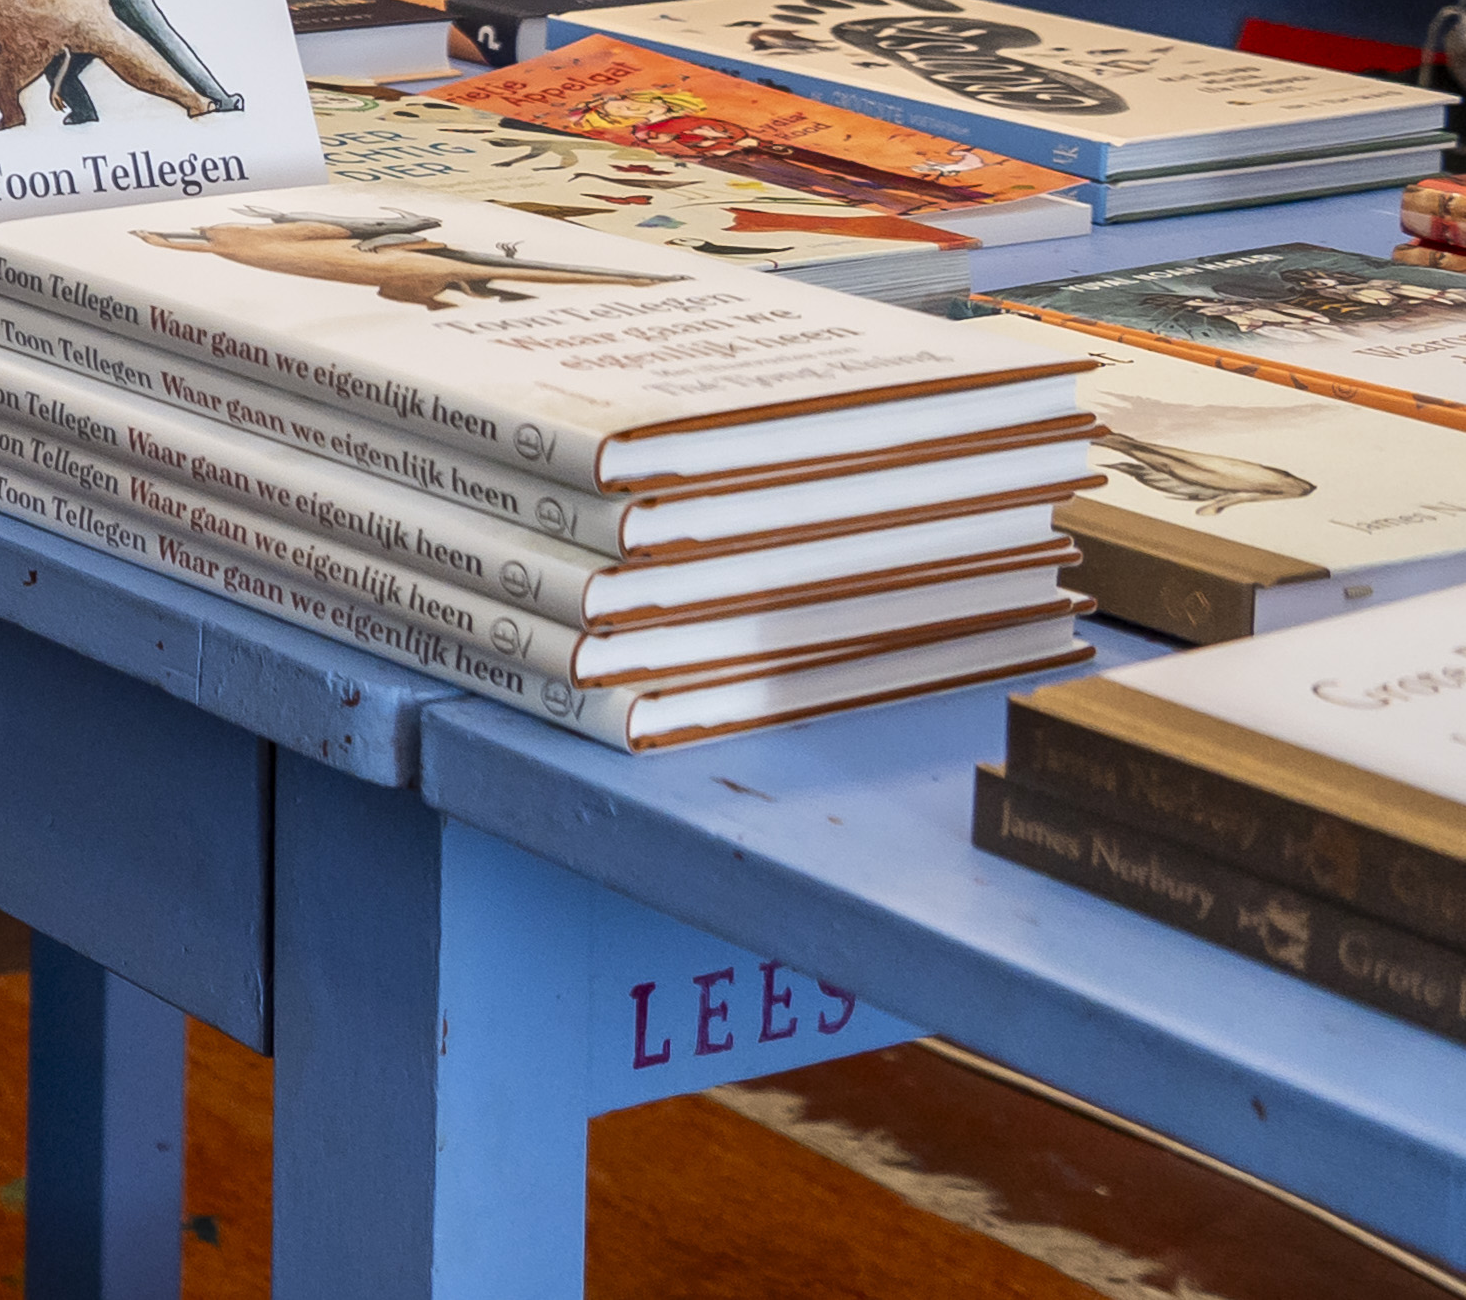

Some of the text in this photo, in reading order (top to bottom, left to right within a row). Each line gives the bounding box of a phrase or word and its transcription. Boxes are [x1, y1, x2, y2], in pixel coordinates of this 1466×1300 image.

[82, 150, 251, 205] Tellegen
[332, 161, 471, 183] DIER
[1133, 264, 1199, 281] NOAH
[1197, 253, 1285, 271] HARARI
[433, 290, 748, 337] Toon Tellegen
[487, 305, 804, 353] Waar gaan we
[747, 324, 866, 353] heen
[47, 275, 141, 330] Tellegen
[149, 303, 209, 350] Waar
[211, 327, 271, 372] gaan
[275, 350, 311, 380] we
[312, 361, 425, 425] eigenlijk
[431, 391, 499, 443] heen
[0, 317, 522, 516] Toon Tellegen Waar gaan we eigenlijk heen
[24, 390, 119, 447] Tellegen
[126, 425, 188, 471] Waar
[190, 451, 250, 497] gaan
[255, 480, 291, 508] we
[294, 490, 410, 550] eigenlijk
[414, 529, 485, 580] heen
[29, 437, 120, 496] Tellegen
[127, 475, 188, 524] Waar
[189, 504, 249, 550] gaan
[253, 532, 288, 563] we
[291, 543, 404, 610] eigenlijk
[408, 582, 475, 635] heen
[1332, 505, 1440, 535] James
[50, 494, 148, 553] Tellegen
[156, 532, 219, 581] Waar
[222, 563, 284, 610] gaan
[289, 588, 326, 618] we
[329, 601, 448, 666] eigenlijk
[453, 641, 525, 695] heen
[1001, 799, 1081, 860] James
[1090, 839, 1215, 921] Norbury
